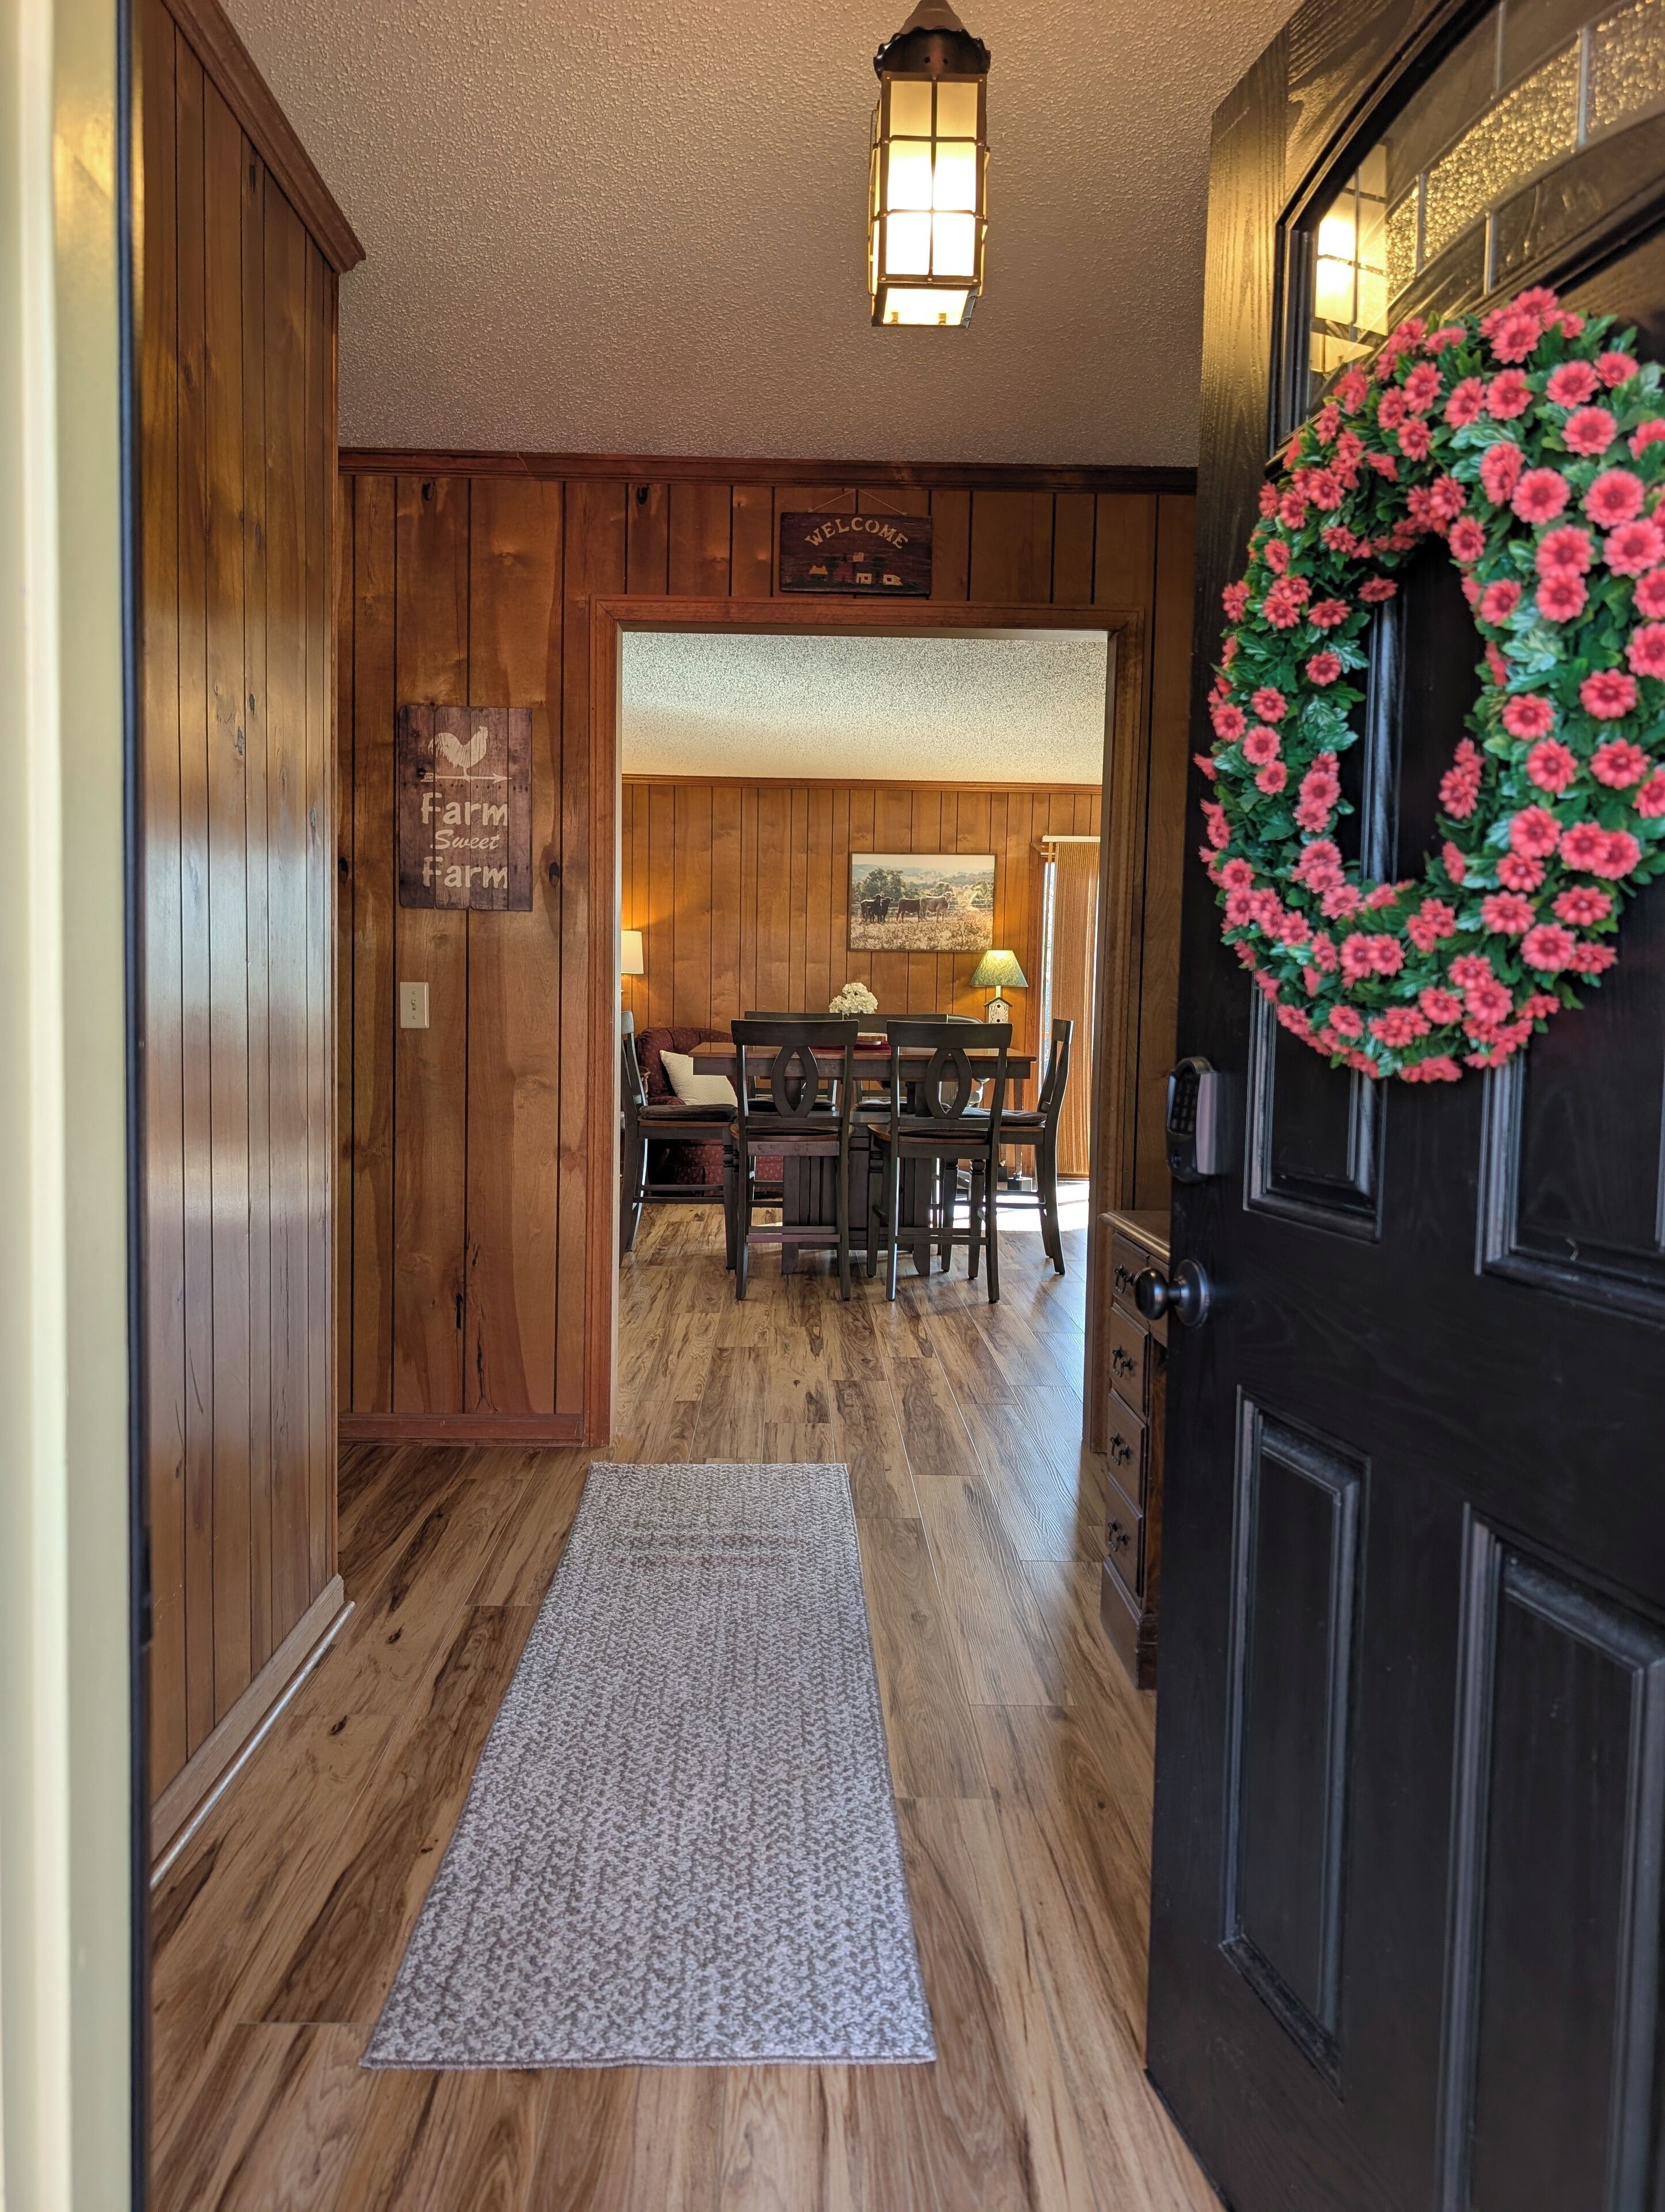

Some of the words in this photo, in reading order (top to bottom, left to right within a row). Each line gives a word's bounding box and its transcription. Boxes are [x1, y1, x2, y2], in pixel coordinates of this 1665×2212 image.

[805, 517, 908, 548] WELCOME
[420, 792, 508, 826] Farm
[430, 830, 500, 850] Sweet
[422, 856, 508, 889] Farm
